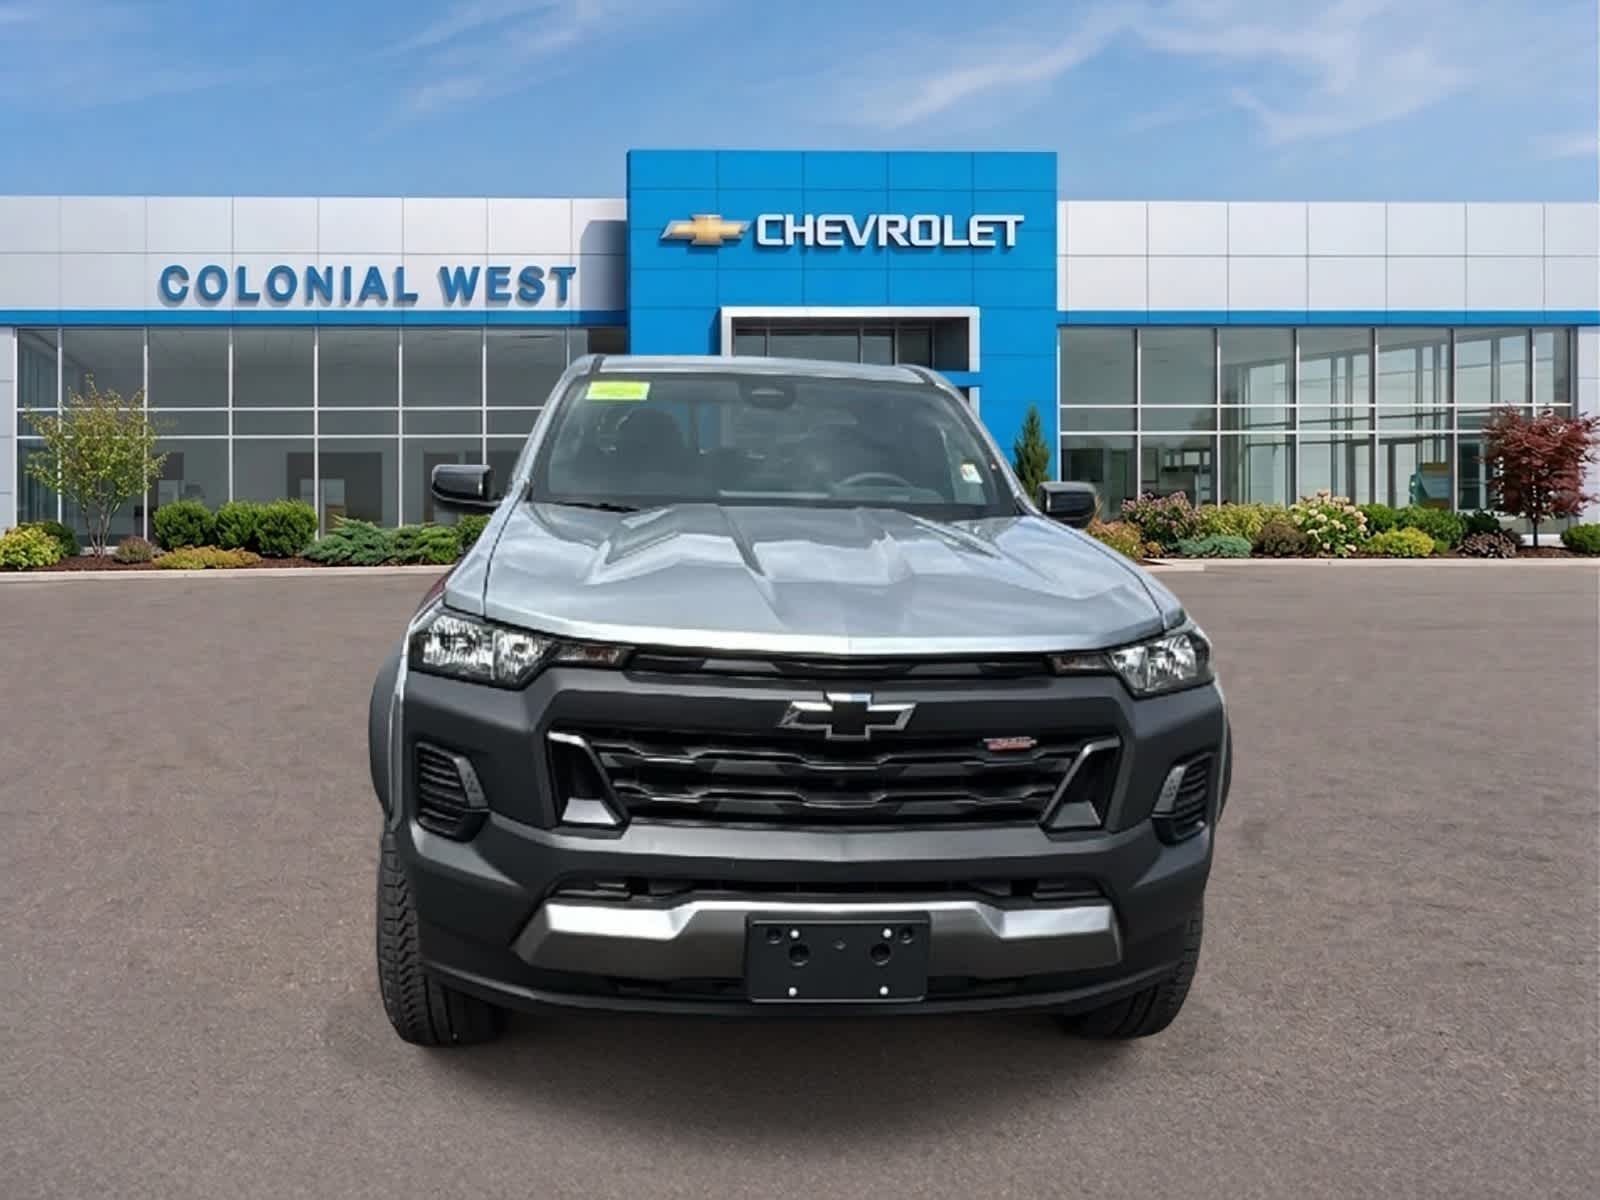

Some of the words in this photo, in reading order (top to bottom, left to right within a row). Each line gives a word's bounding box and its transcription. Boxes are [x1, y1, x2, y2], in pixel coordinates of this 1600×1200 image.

[756, 213, 1025, 248] CHEVROLET
[158, 264, 419, 304] COLONIAL
[438, 265, 577, 304] WEST
